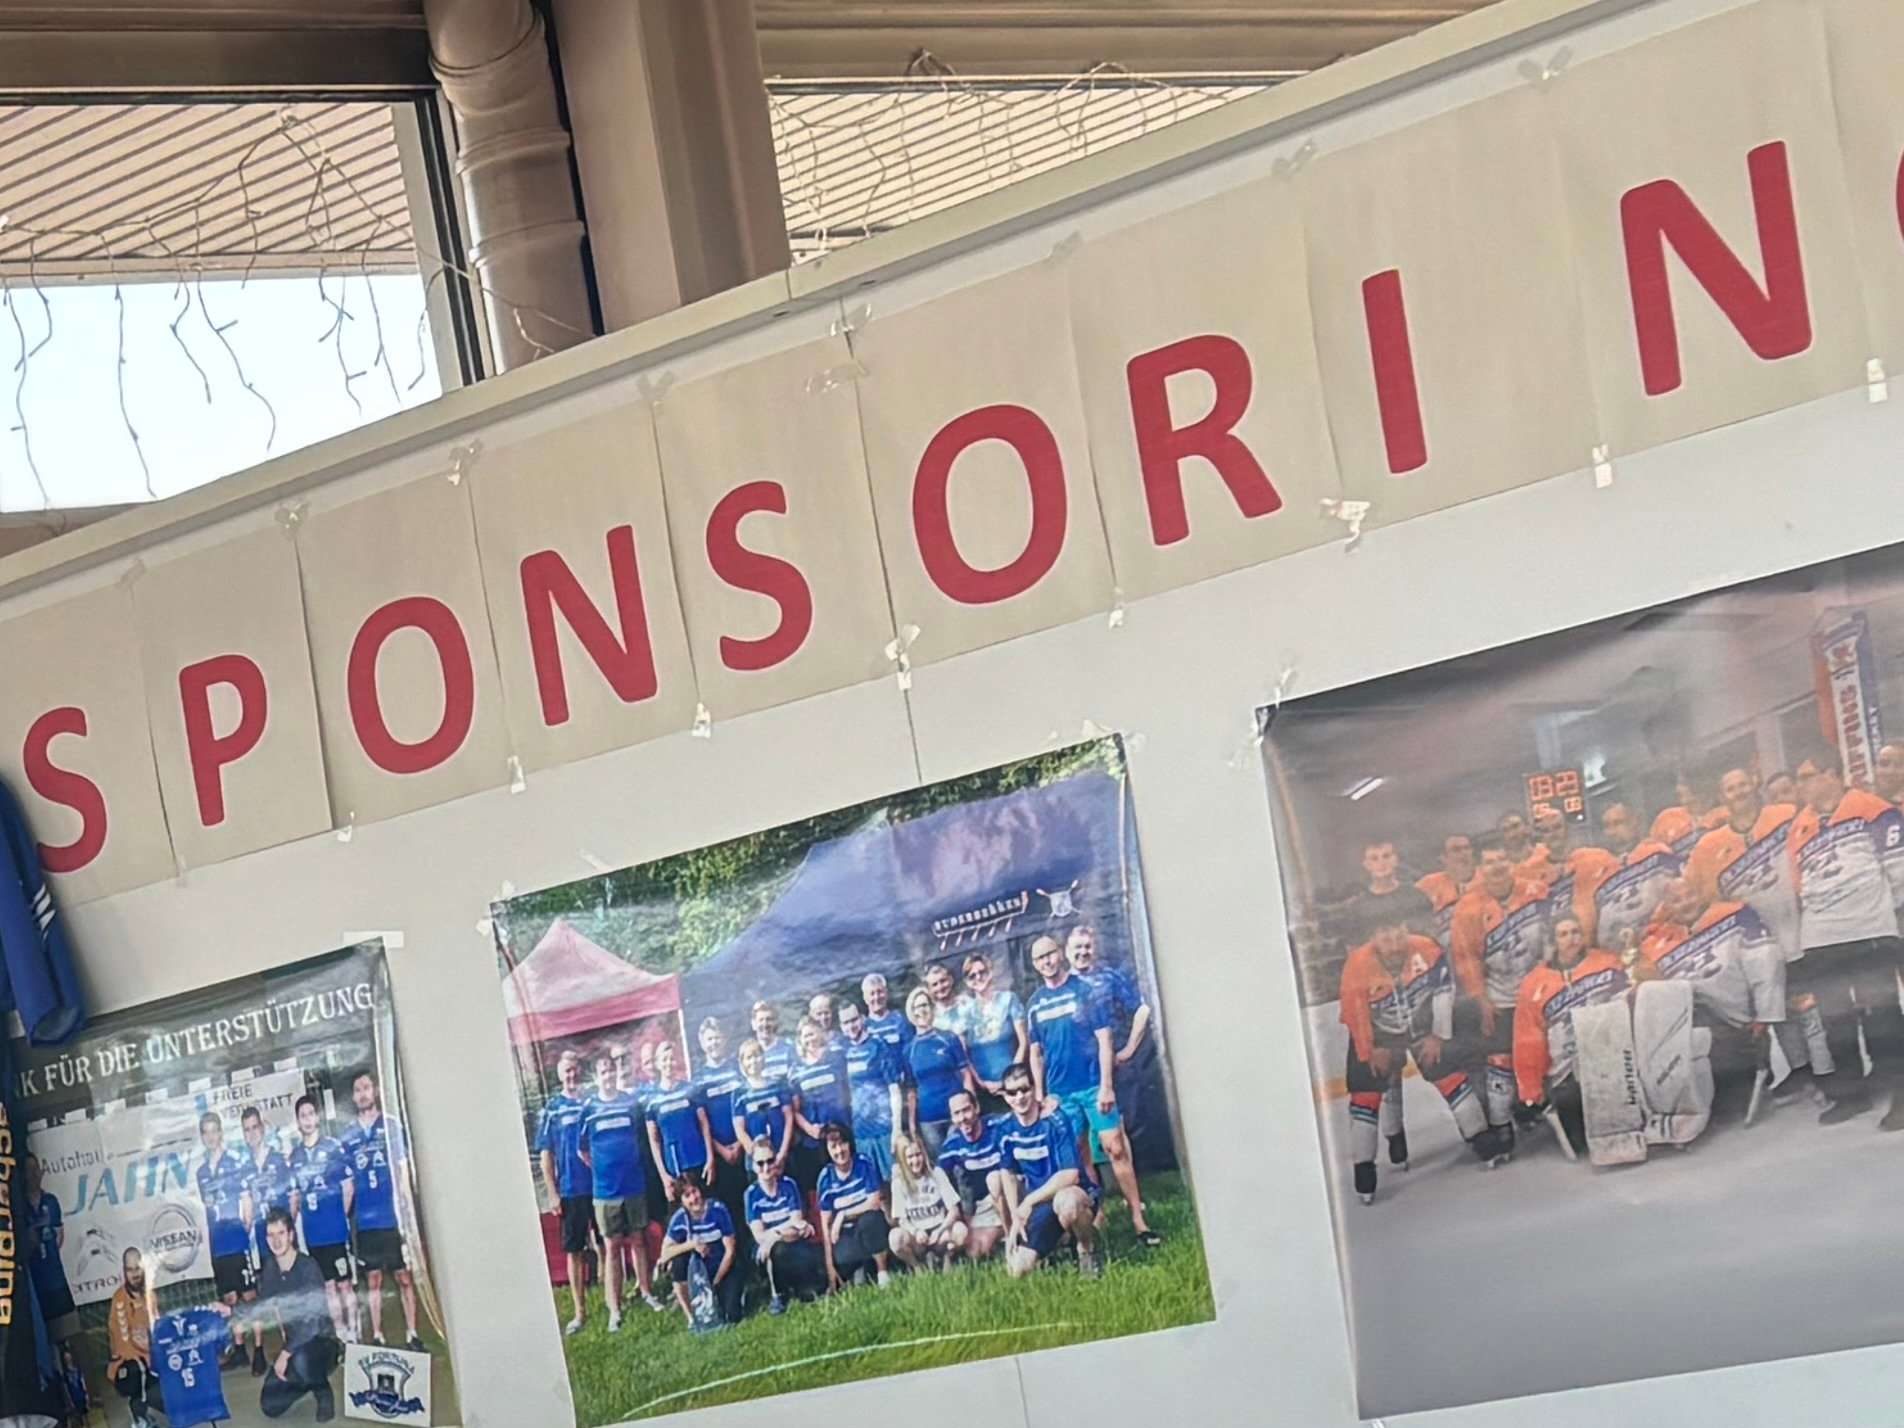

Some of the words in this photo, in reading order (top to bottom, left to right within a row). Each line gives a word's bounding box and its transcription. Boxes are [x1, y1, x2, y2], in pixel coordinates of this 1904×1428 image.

[44, 1054, 92, 1089] FÜR
[98, 1042, 138, 1078] DIE
[146, 982, 374, 1063] UNTERSTÜTZUNG
[64, 1149, 193, 1217] JAHN
